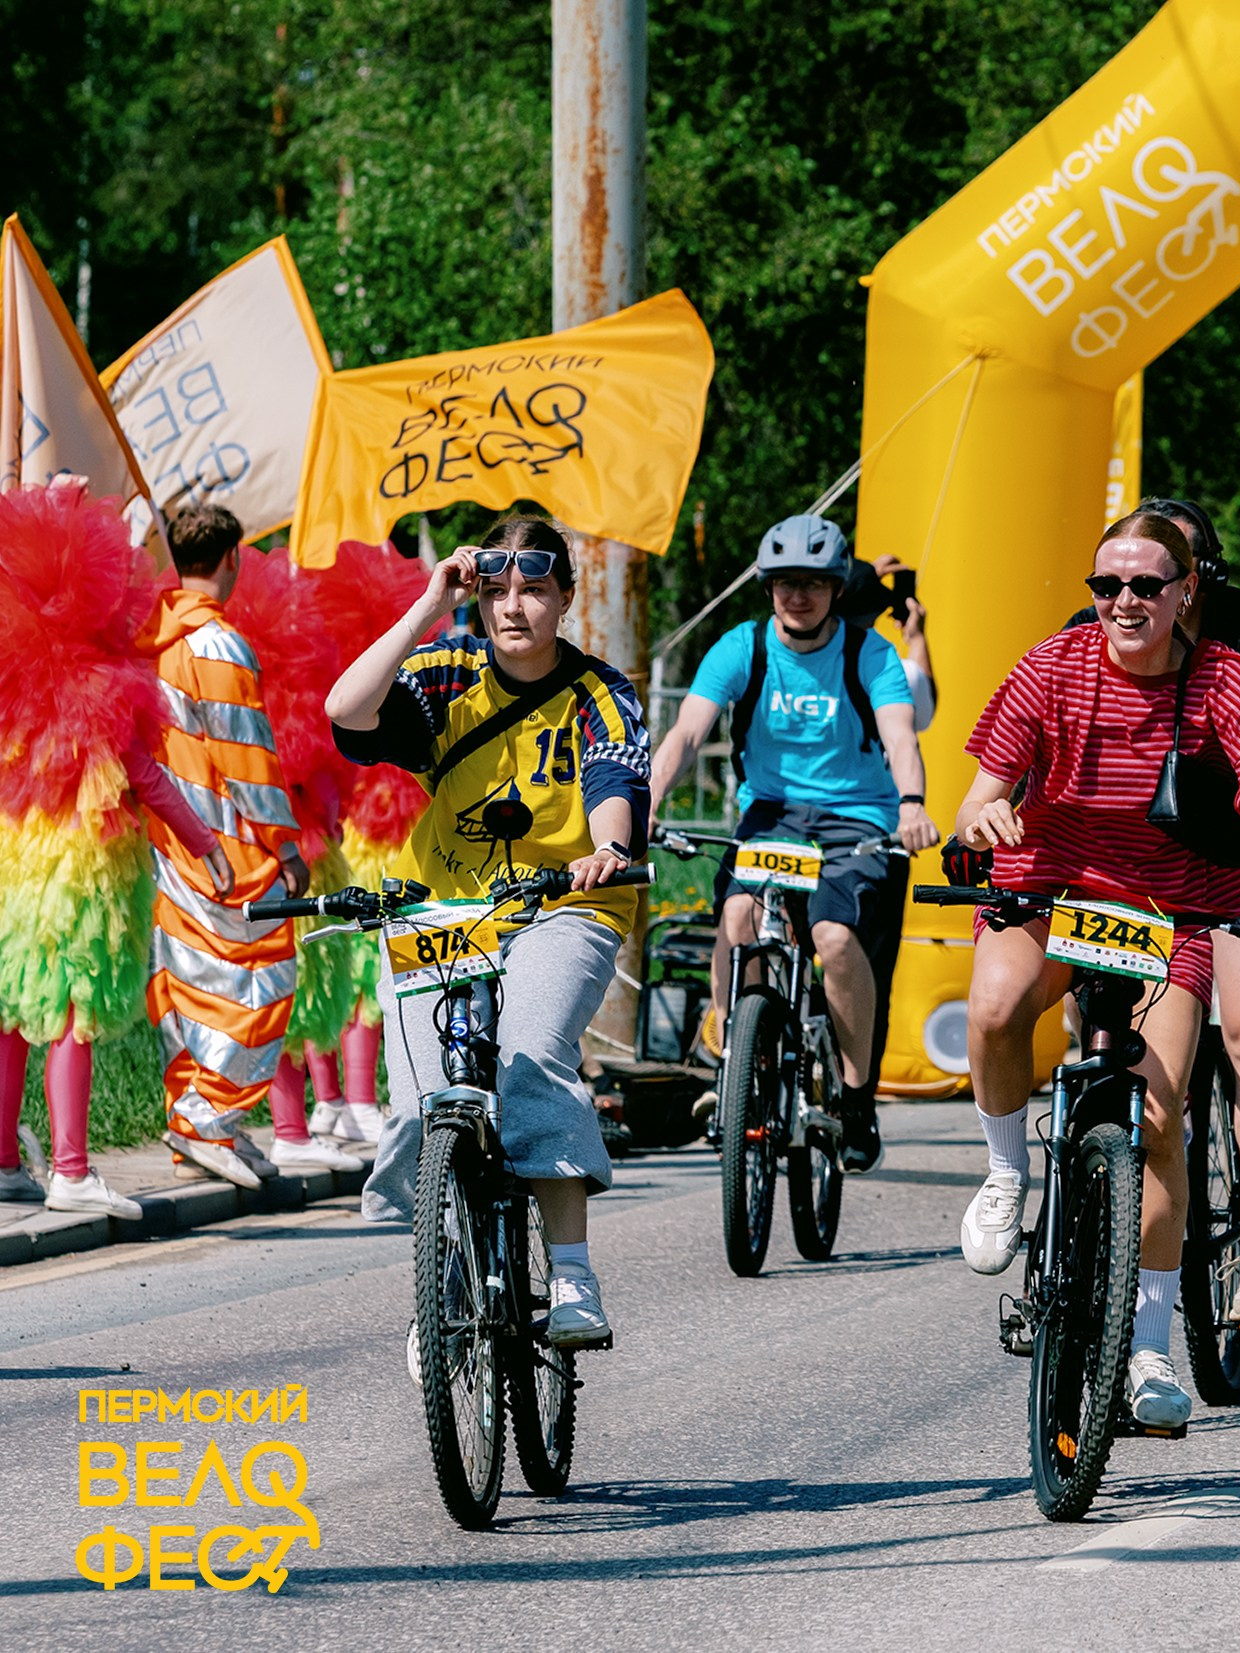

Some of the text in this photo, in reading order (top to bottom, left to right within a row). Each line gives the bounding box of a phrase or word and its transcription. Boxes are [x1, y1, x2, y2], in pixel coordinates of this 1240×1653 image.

[977, 93, 1156, 259] ПЕРМСКИЙ
[1006, 136, 1199, 316] ВЕЛО
[530, 727, 576, 786] 15
[752, 852, 804, 875] 1051
[416, 926, 470, 963] 874
[1070, 910, 1152, 951] 1244
